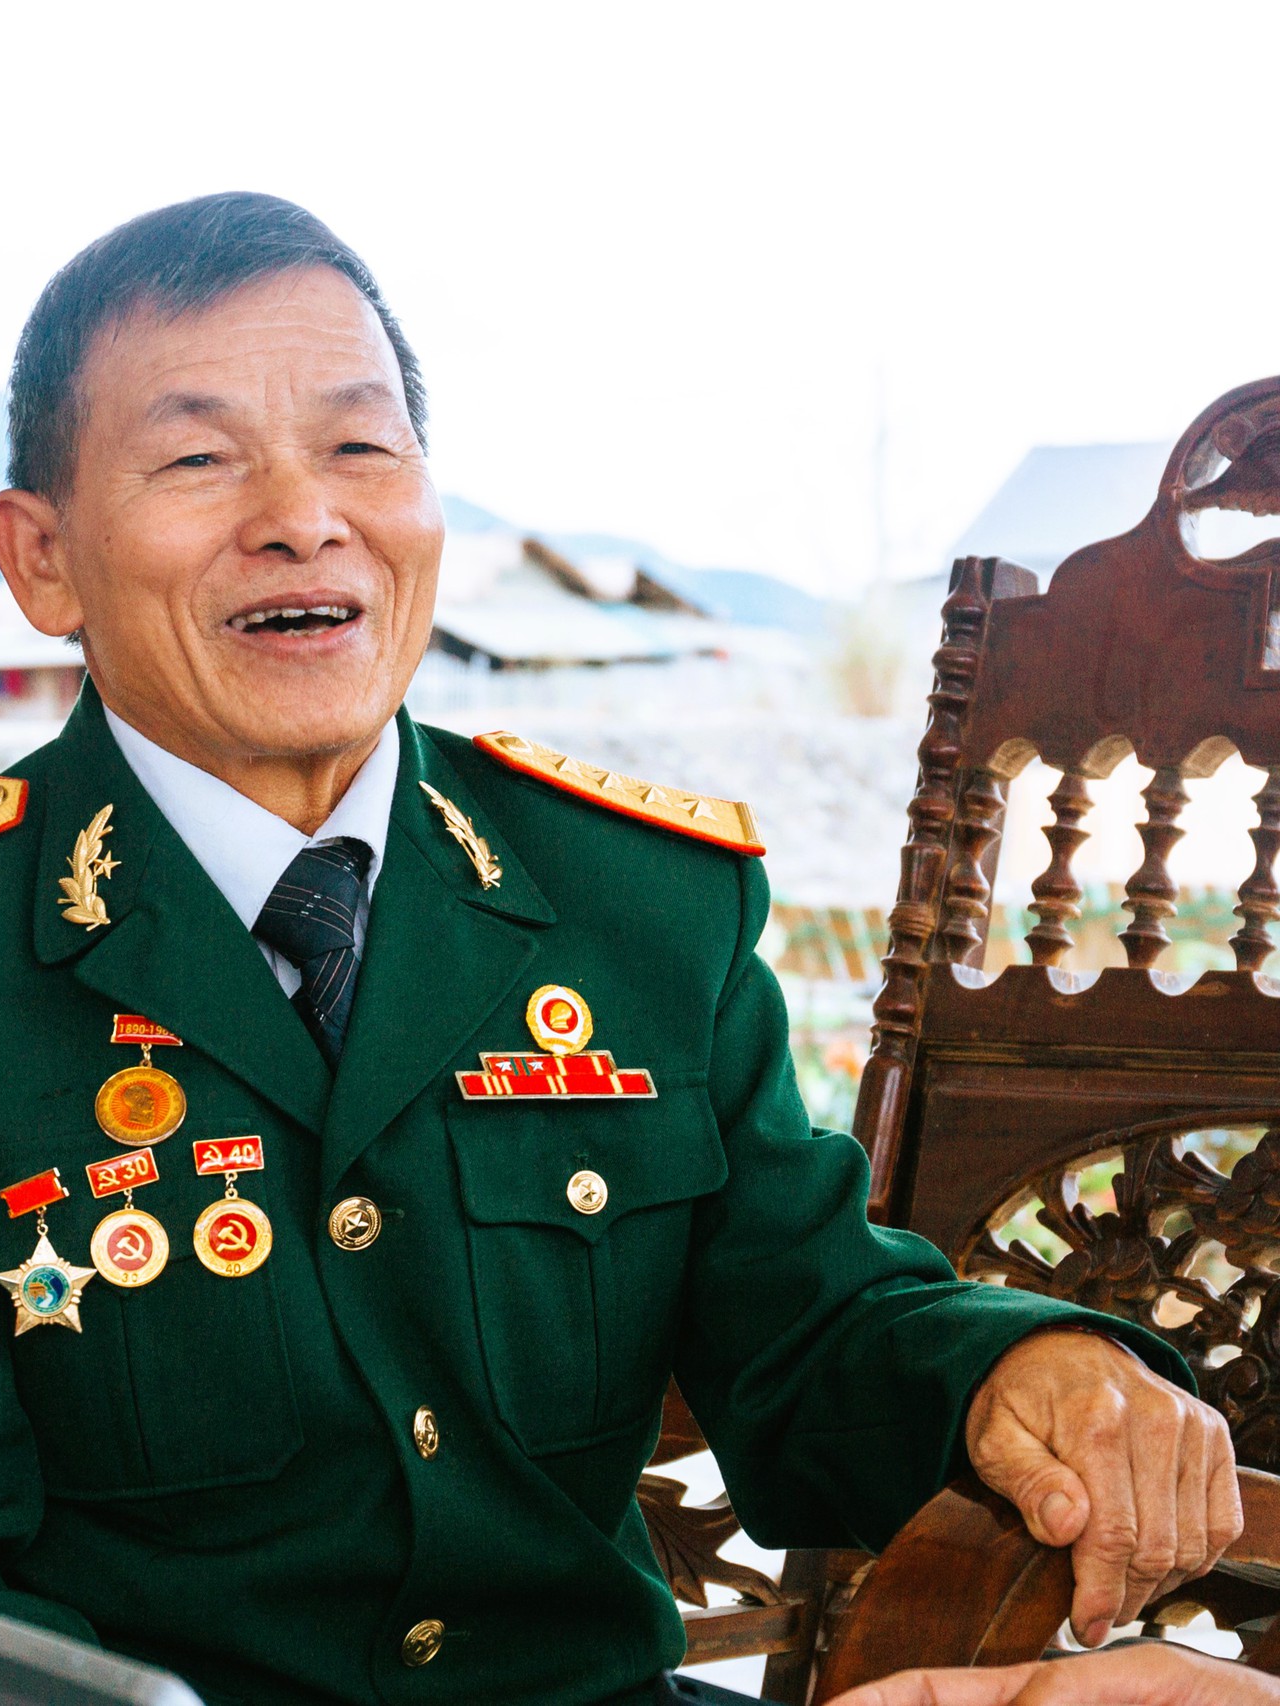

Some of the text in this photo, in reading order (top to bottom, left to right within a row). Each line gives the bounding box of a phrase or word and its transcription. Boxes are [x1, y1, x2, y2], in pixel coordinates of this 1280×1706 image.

[119, 1023, 176, 1036] 1890-196
[228, 1144, 255, 1164] 40
[120, 1156, 149, 1180] 30
[225, 1263, 241, 1275] 40
